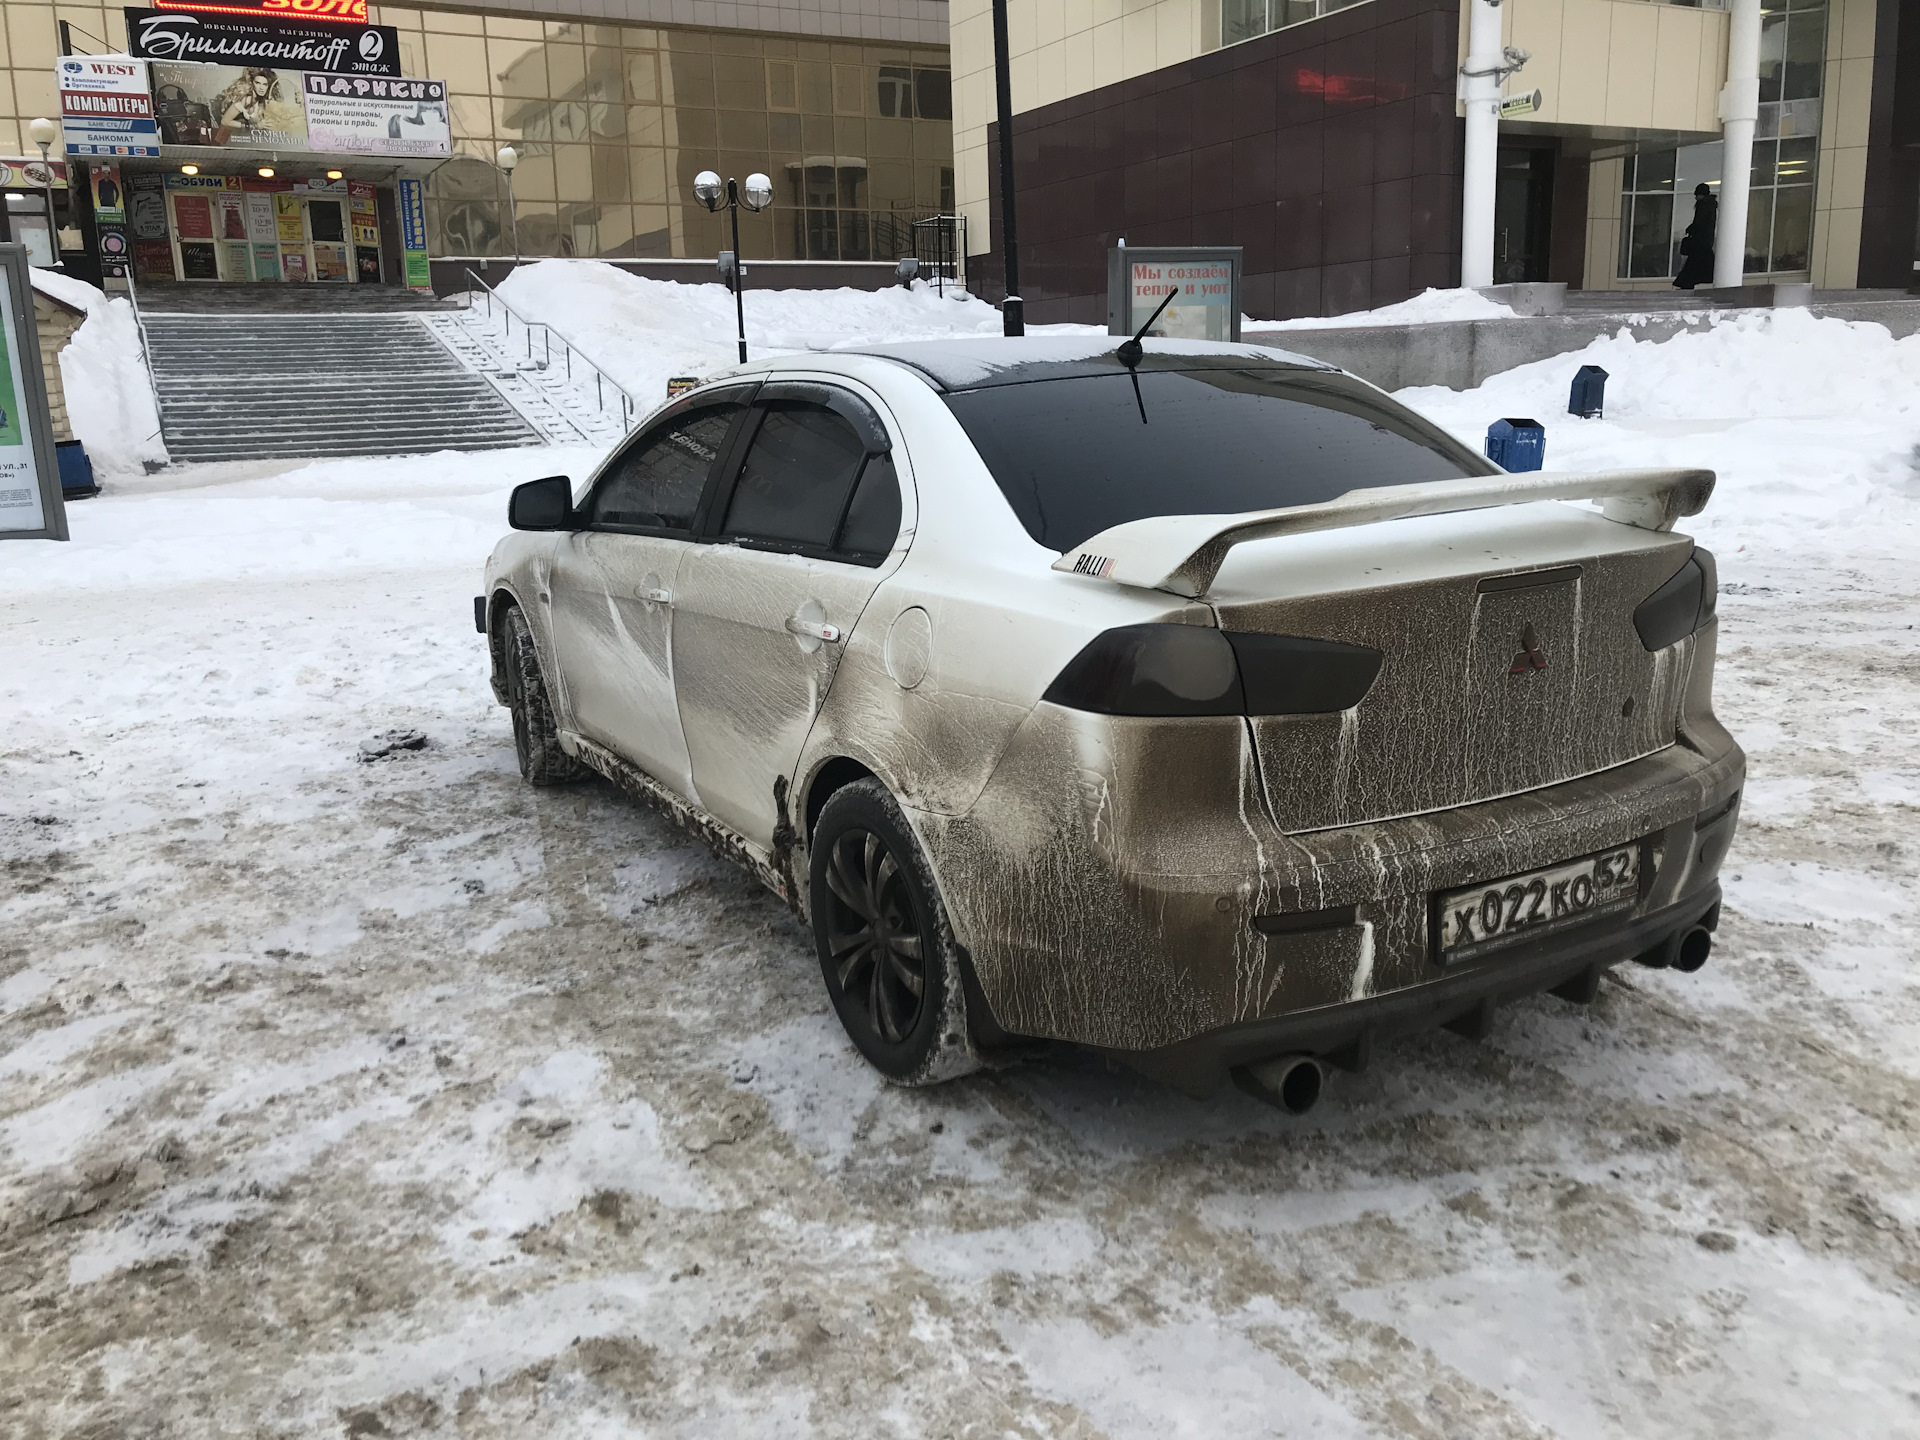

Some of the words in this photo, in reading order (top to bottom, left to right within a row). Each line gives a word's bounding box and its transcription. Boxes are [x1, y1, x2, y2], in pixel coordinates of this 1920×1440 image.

[203, 22, 269, 35] ювелирные
[278, 27, 333, 39] магазины
[366, 33, 380, 60] 2
[90, 63, 136, 76] WEST
[351, 61, 391, 73] этаж
[309, 76, 426, 99] ПАРИКИ
[64, 95, 149, 114] КОМПЬЮТЕРЫ
[309, 97, 356, 108] Натуральные
[363, 102, 414, 110] искусственные
[310, 108, 342, 117] парики,
[343, 110, 383, 119] шиньоны,
[311, 118, 342, 126] локоны
[351, 120, 378, 128] пряди.
[87, 134, 135, 143] БАНКОМАТ
[251, 129, 286, 138] СУМКИ
[252, 136, 306, 145] ЧЕМОДАНЫ
[181, 177, 223, 187] ОБУВИ
[228, 177, 236, 186] 2
[407, 241, 413, 249] 2
[1133, 265, 1161, 280] Мы
[1168, 265, 1229, 279] создаём
[1185, 284, 1195, 295] и
[1202, 283, 1229, 297] уют
[1072, 553, 1107, 577] RALLI
